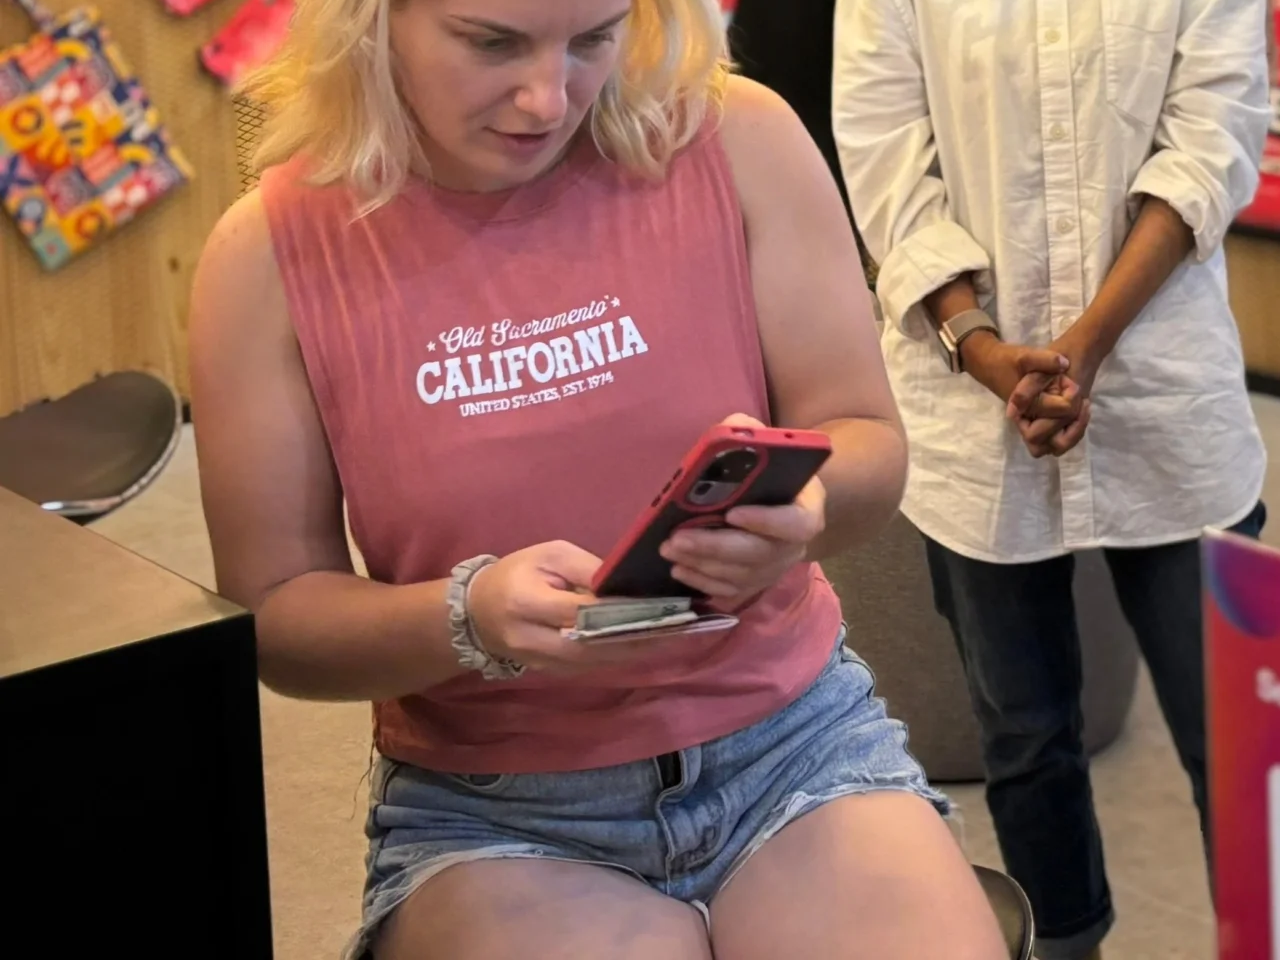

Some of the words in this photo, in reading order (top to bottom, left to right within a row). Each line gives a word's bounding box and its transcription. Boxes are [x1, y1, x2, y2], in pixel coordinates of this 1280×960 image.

[439, 326, 485, 354] Old
[491, 299, 608, 346] Sacramento
[416, 315, 648, 404] CALIFORNIA
[459, 398, 510, 417] UNITED
